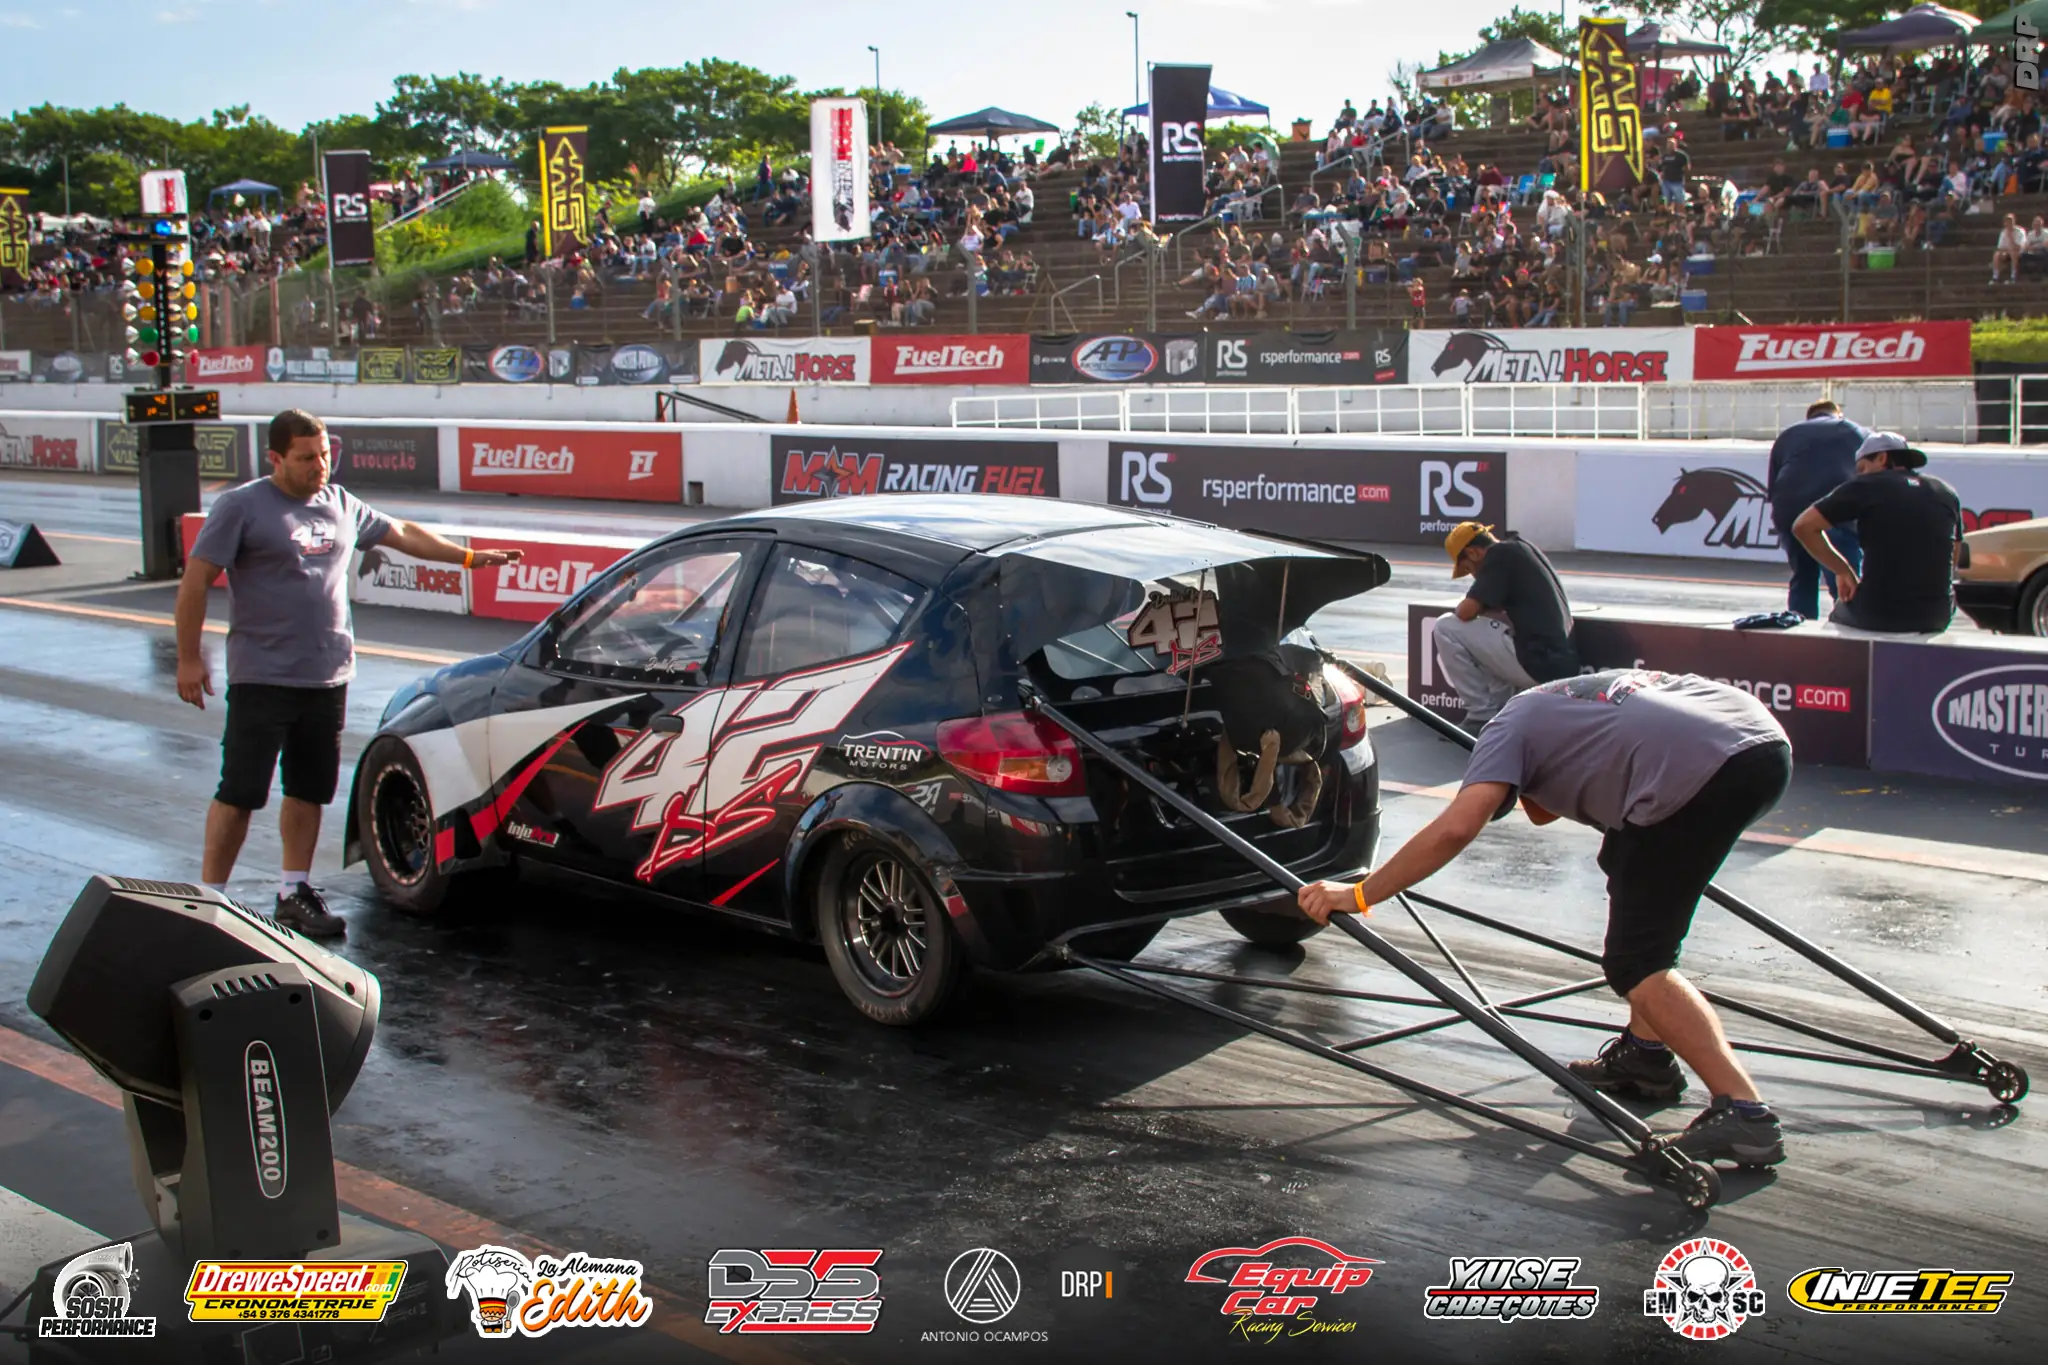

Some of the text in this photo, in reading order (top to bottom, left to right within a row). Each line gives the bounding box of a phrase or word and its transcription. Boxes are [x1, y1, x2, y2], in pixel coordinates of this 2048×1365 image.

[1162, 122, 1203, 153] RS
[333, 193, 368, 217] RS
[895, 345, 1004, 369] FuelTech
[1216, 340, 1249, 369] RS
[1737, 330, 1925, 365] FuelTech
[472, 441, 575, 470] FuelTech
[884, 463, 979, 493] RACING
[981, 466, 1046, 495] FUEL
[1120, 451, 1173, 503] RS
[1420, 460, 1484, 517] RS
[844, 743, 922, 763] TRENTIN
[849, 760, 908, 771] MOTORS
[1989, 743, 2048, 760] TUR
[250, 1058, 282, 1183] BEAM200
